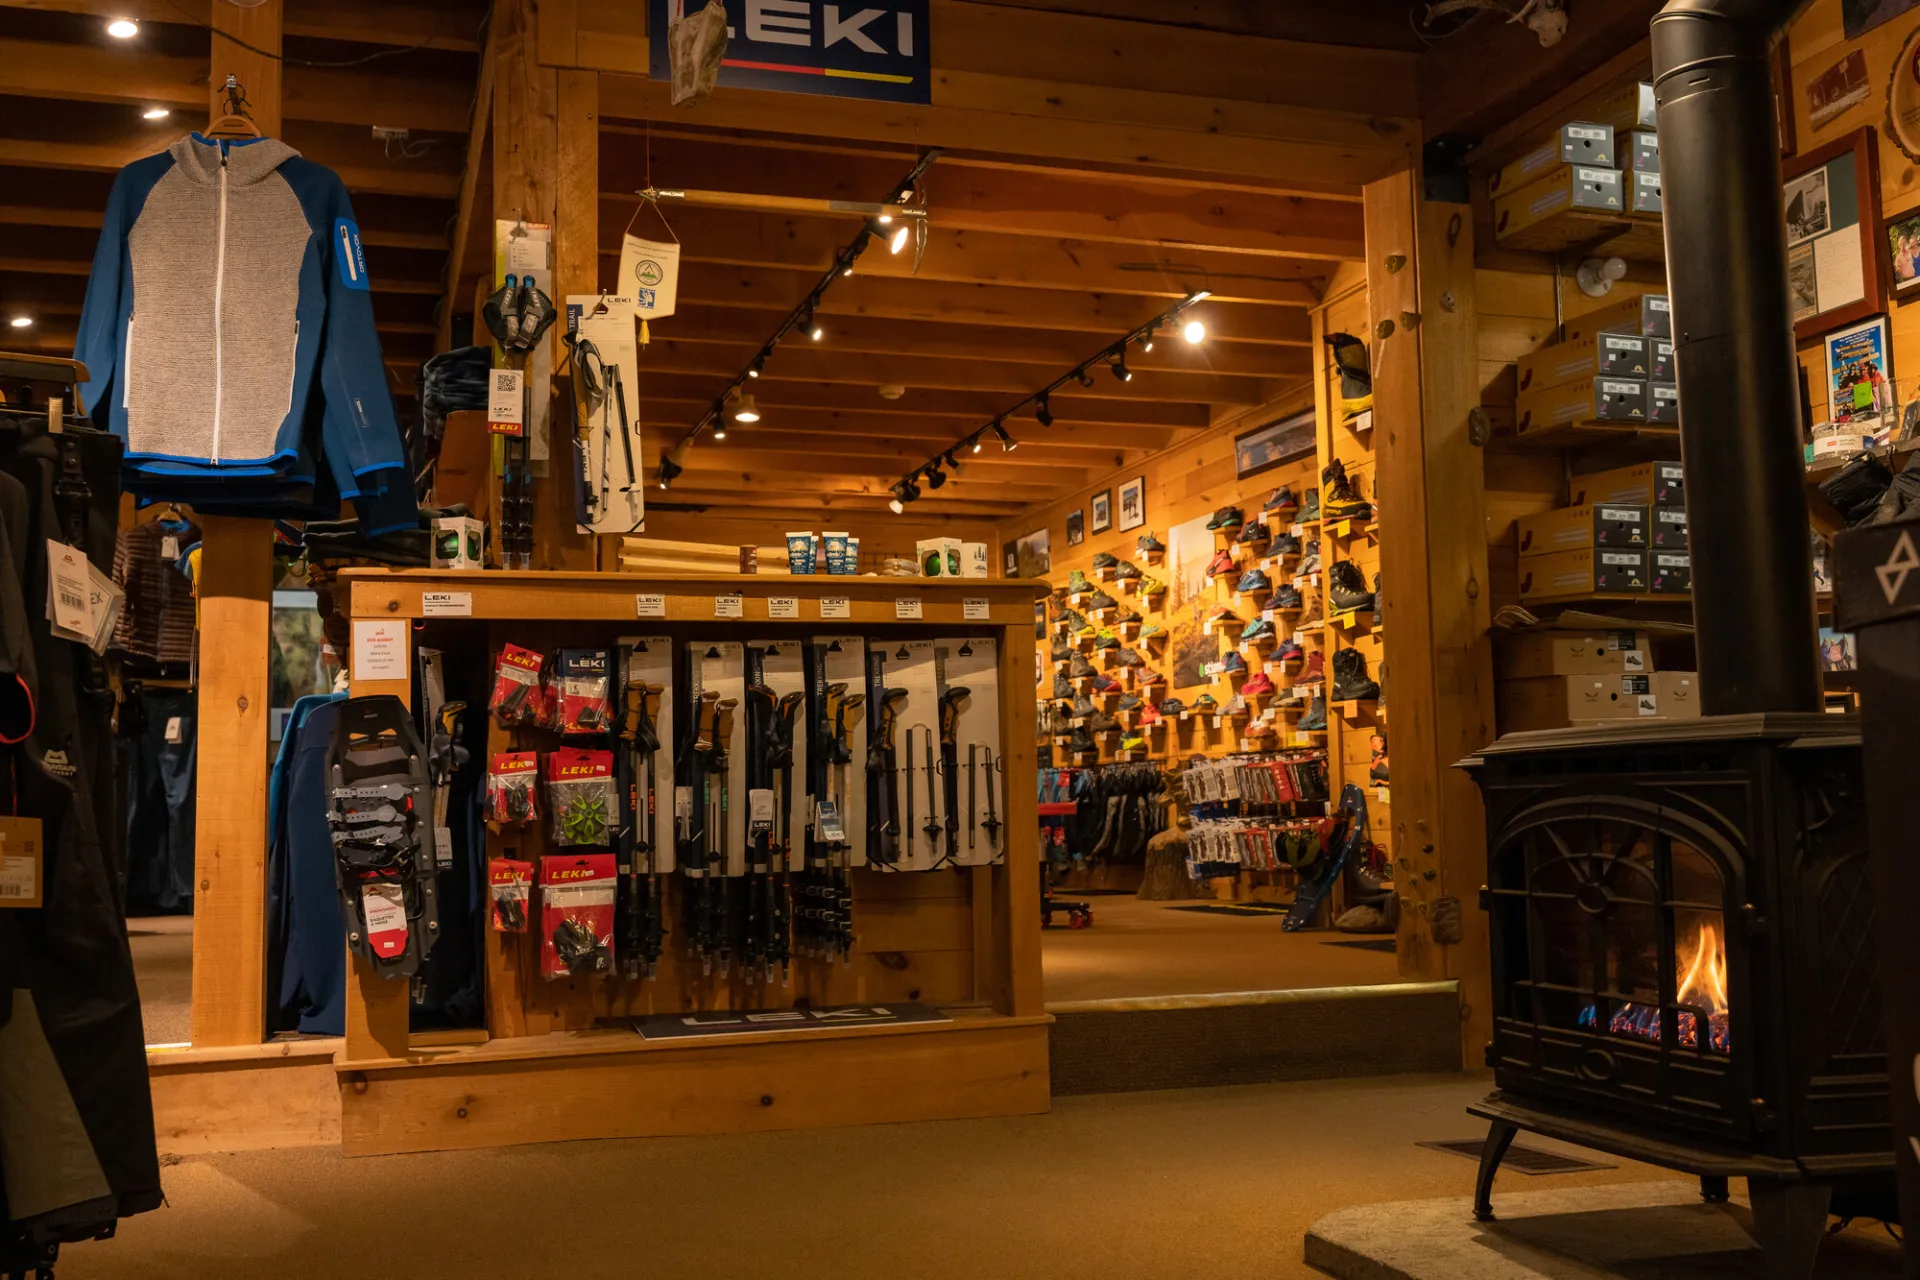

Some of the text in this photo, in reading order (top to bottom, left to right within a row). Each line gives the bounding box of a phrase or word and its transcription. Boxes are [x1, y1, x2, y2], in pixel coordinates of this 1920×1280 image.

[353, 233, 365, 273] ORTOVOX
[568, 308, 576, 329] TRAIL
[492, 423, 518, 431] LEKI
[506, 653, 535, 668] LEKI
[569, 659, 604, 668] LEKI
[500, 761, 528, 770] LEK
[561, 765, 594, 775] LEKI
[495, 871, 525, 880] LEKI
[681, 1007, 892, 1026] LEKI
